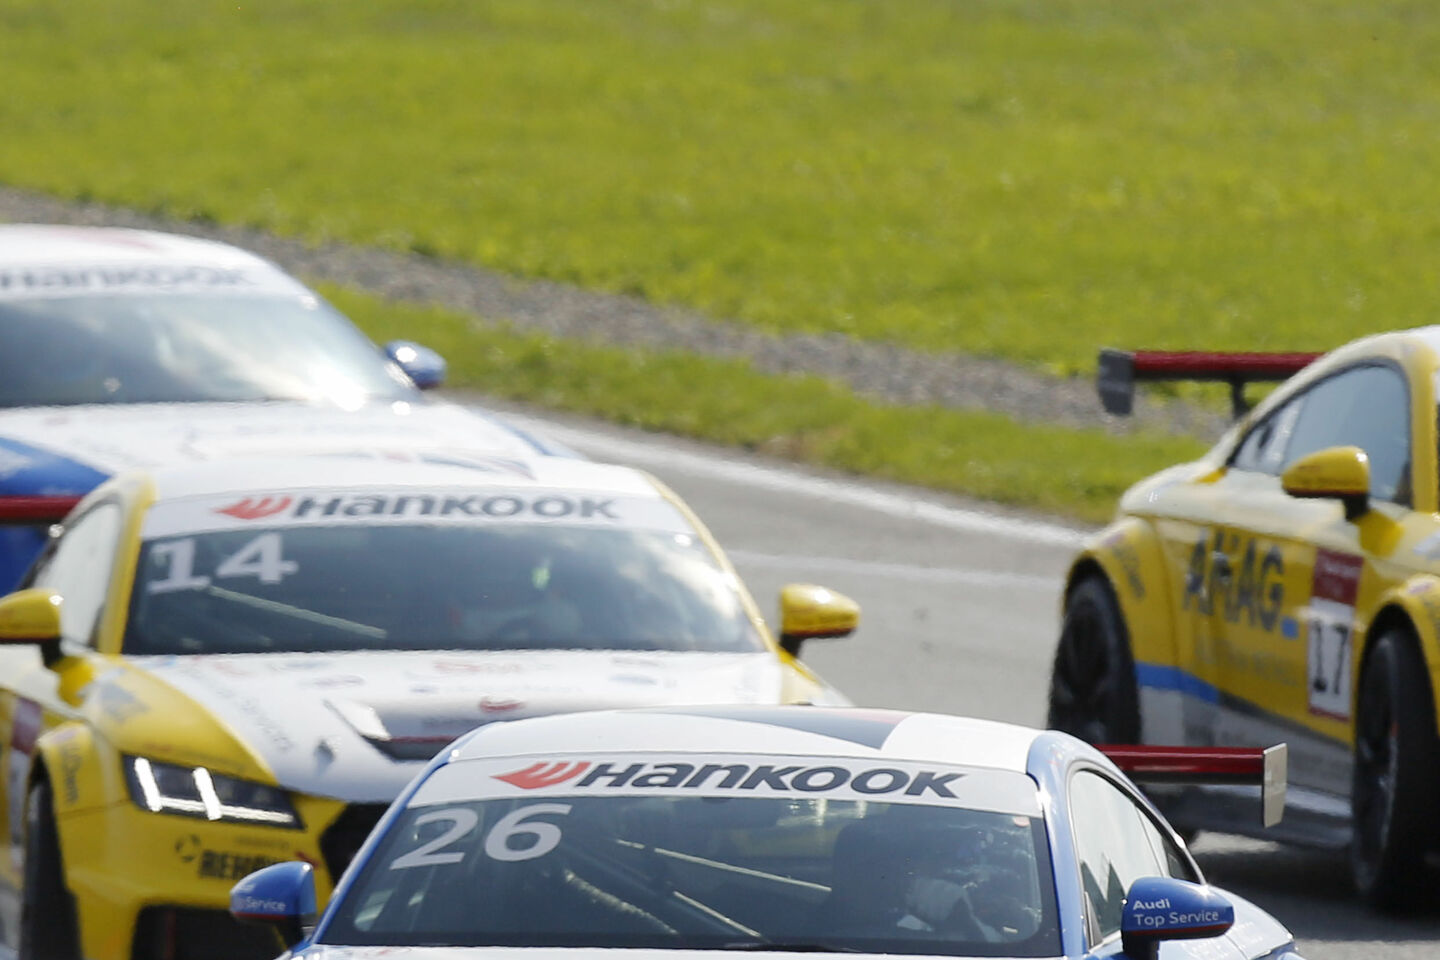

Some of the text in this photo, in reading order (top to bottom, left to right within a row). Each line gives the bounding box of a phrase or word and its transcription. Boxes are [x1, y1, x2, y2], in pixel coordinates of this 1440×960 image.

[146, 531, 298, 594] 14
[390, 803, 571, 871] 26
[1133, 898, 1171, 910] Audi
[1134, 910, 1219, 928] Top Service
